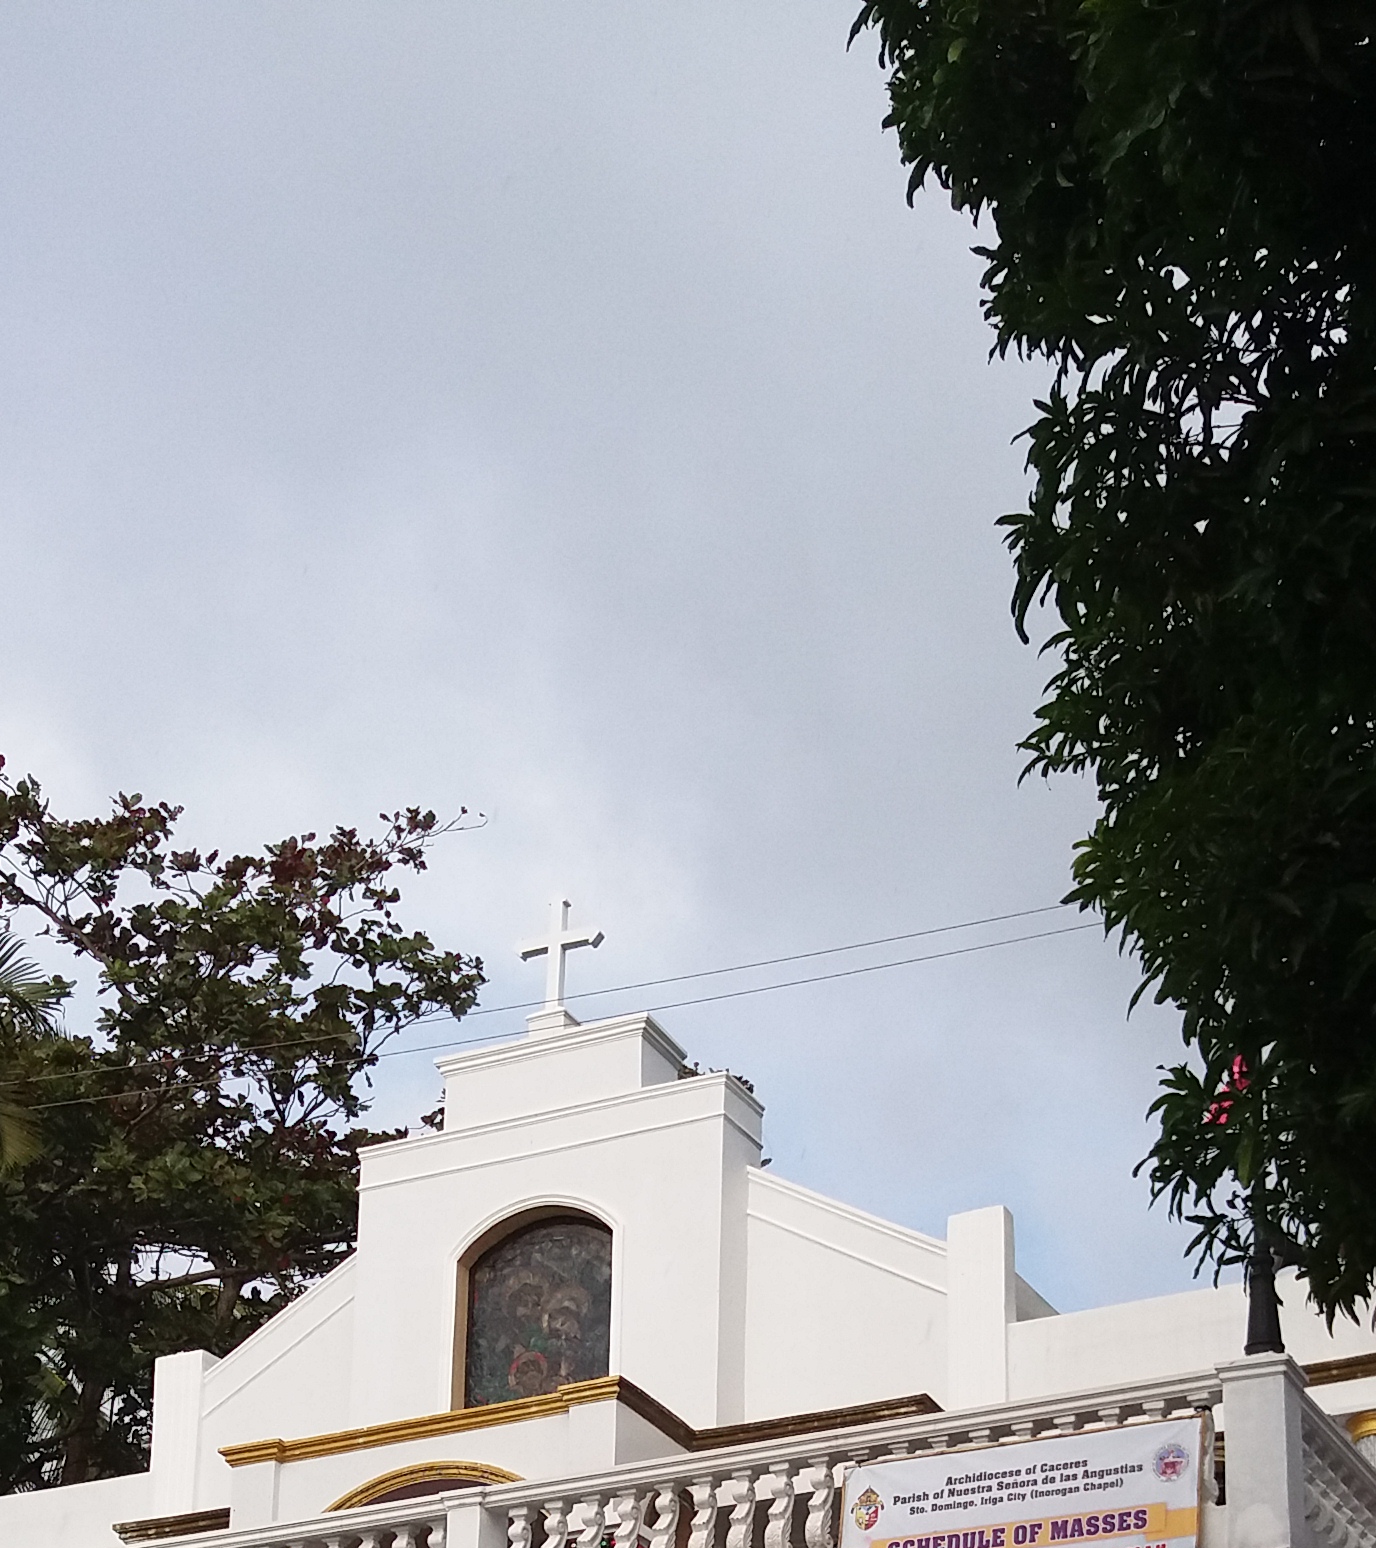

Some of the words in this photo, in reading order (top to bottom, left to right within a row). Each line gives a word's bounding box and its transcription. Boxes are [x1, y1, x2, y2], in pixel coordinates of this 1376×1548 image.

[893, 1492, 929, 1506] Parish
[933, 1490, 945, 1499] of
[947, 1485, 993, 1498] Nuestra
[996, 1478, 1038, 1491] Señora
[1041, 1475, 1056, 1485] de
[1059, 1473, 1078, 1482] las
[1082, 1464, 1143, 1480] Angustias
[945, 1468, 1021, 1486] Archidiocese
[1025, 1465, 1037, 1475] of
[1040, 1460, 1088, 1473] Caceres
[909, 1506, 927, 1515] Sto.
[931, 1499, 977, 1512] Domingo,
[980, 1495, 1003, 1506] Iriga
[1007, 1492, 1027, 1502] City
[1030, 1486, 1080, 1499] (Inorogan
[1083, 1478, 1124, 1492] Chapel)
[1013, 1523, 1043, 1544] OF
[1050, 1509, 1147, 1540] MASSES
